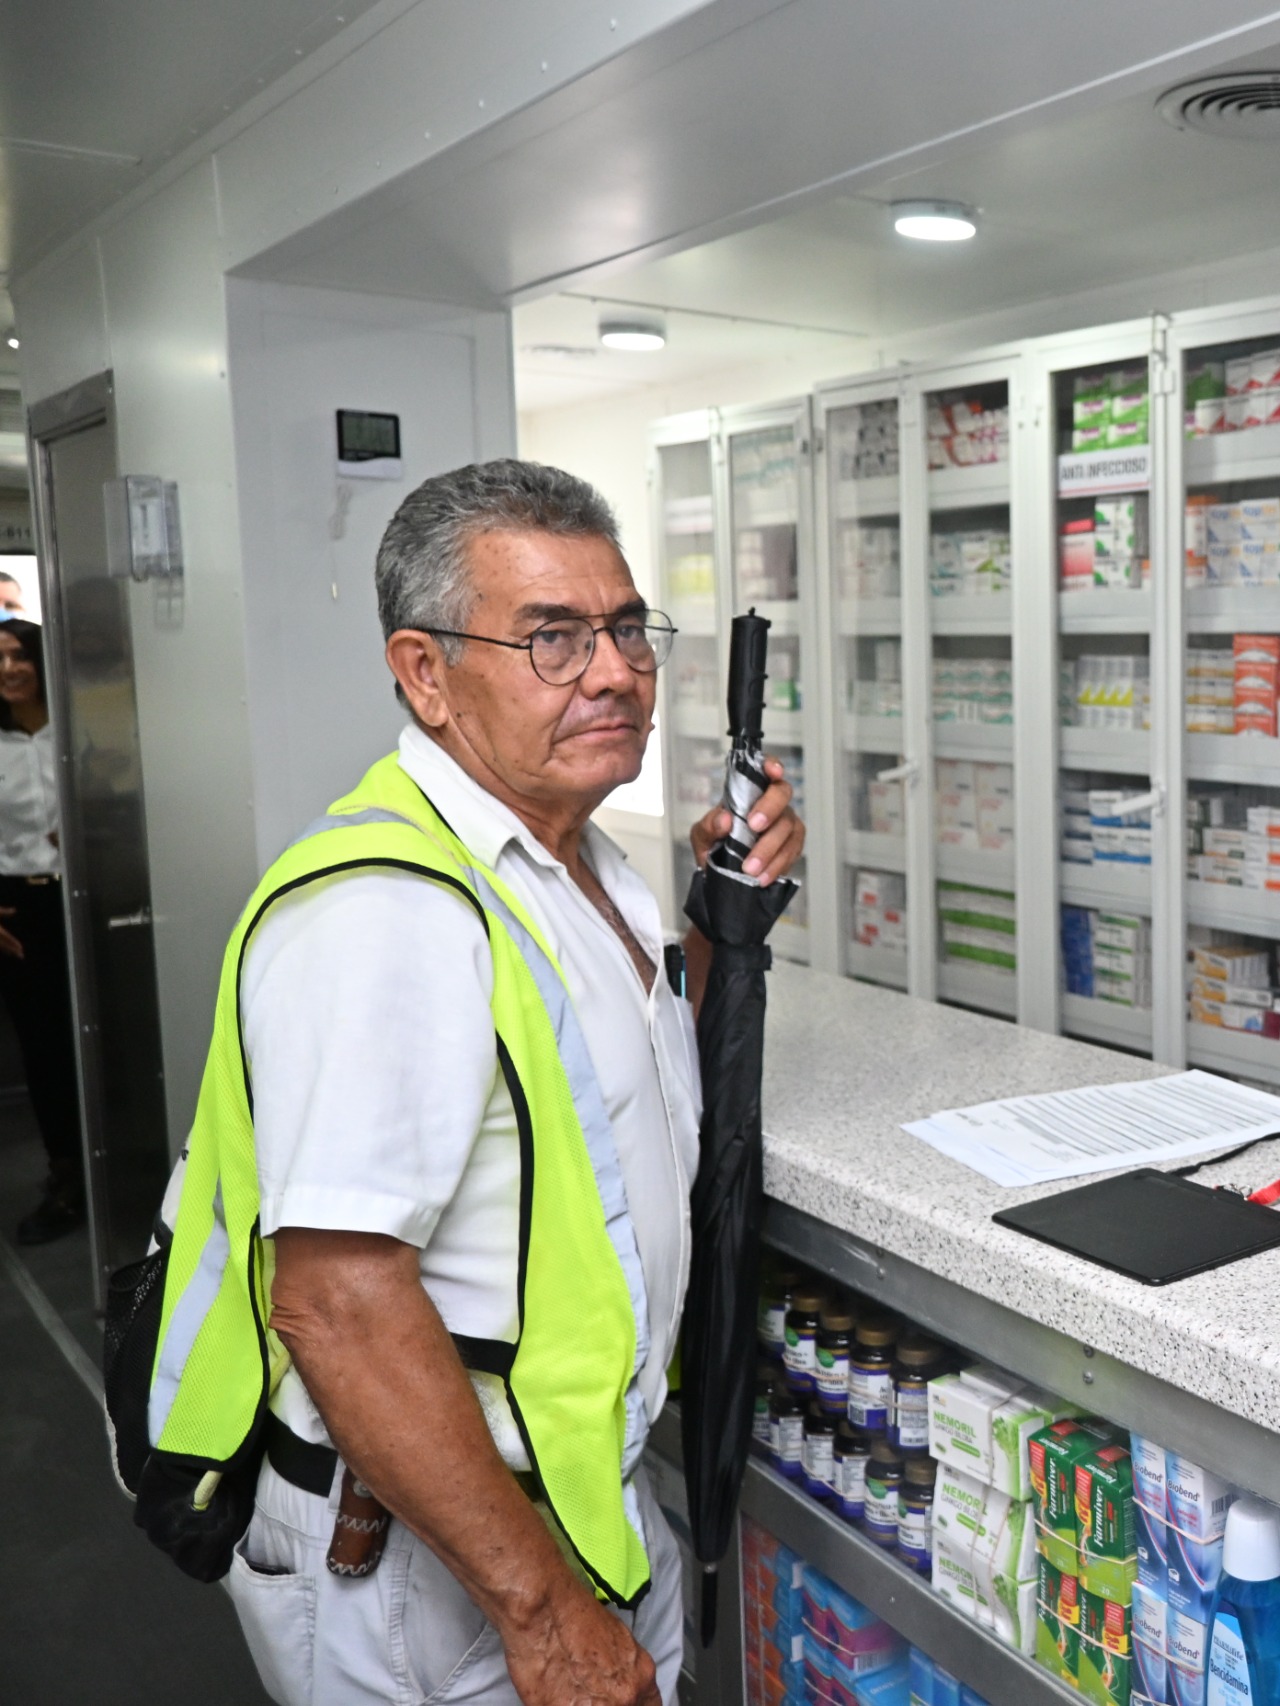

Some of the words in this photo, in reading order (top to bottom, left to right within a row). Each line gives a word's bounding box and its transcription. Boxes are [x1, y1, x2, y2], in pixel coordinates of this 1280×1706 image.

[1088, 457, 1147, 478] INFECCIOSO
[933, 1411, 977, 1438] NEMORIL
[1134, 1462, 1163, 1483] Biobend
[1048, 1458, 1057, 1519] Farmiver
[1168, 1480, 1199, 1501] Biobend
[1094, 1485, 1104, 1547] Farmiver
[1134, 1614, 1162, 1638] Biobend
[1168, 1636, 1200, 1660] Biobend
[1209, 1658, 1249, 1695] Bencidamina
